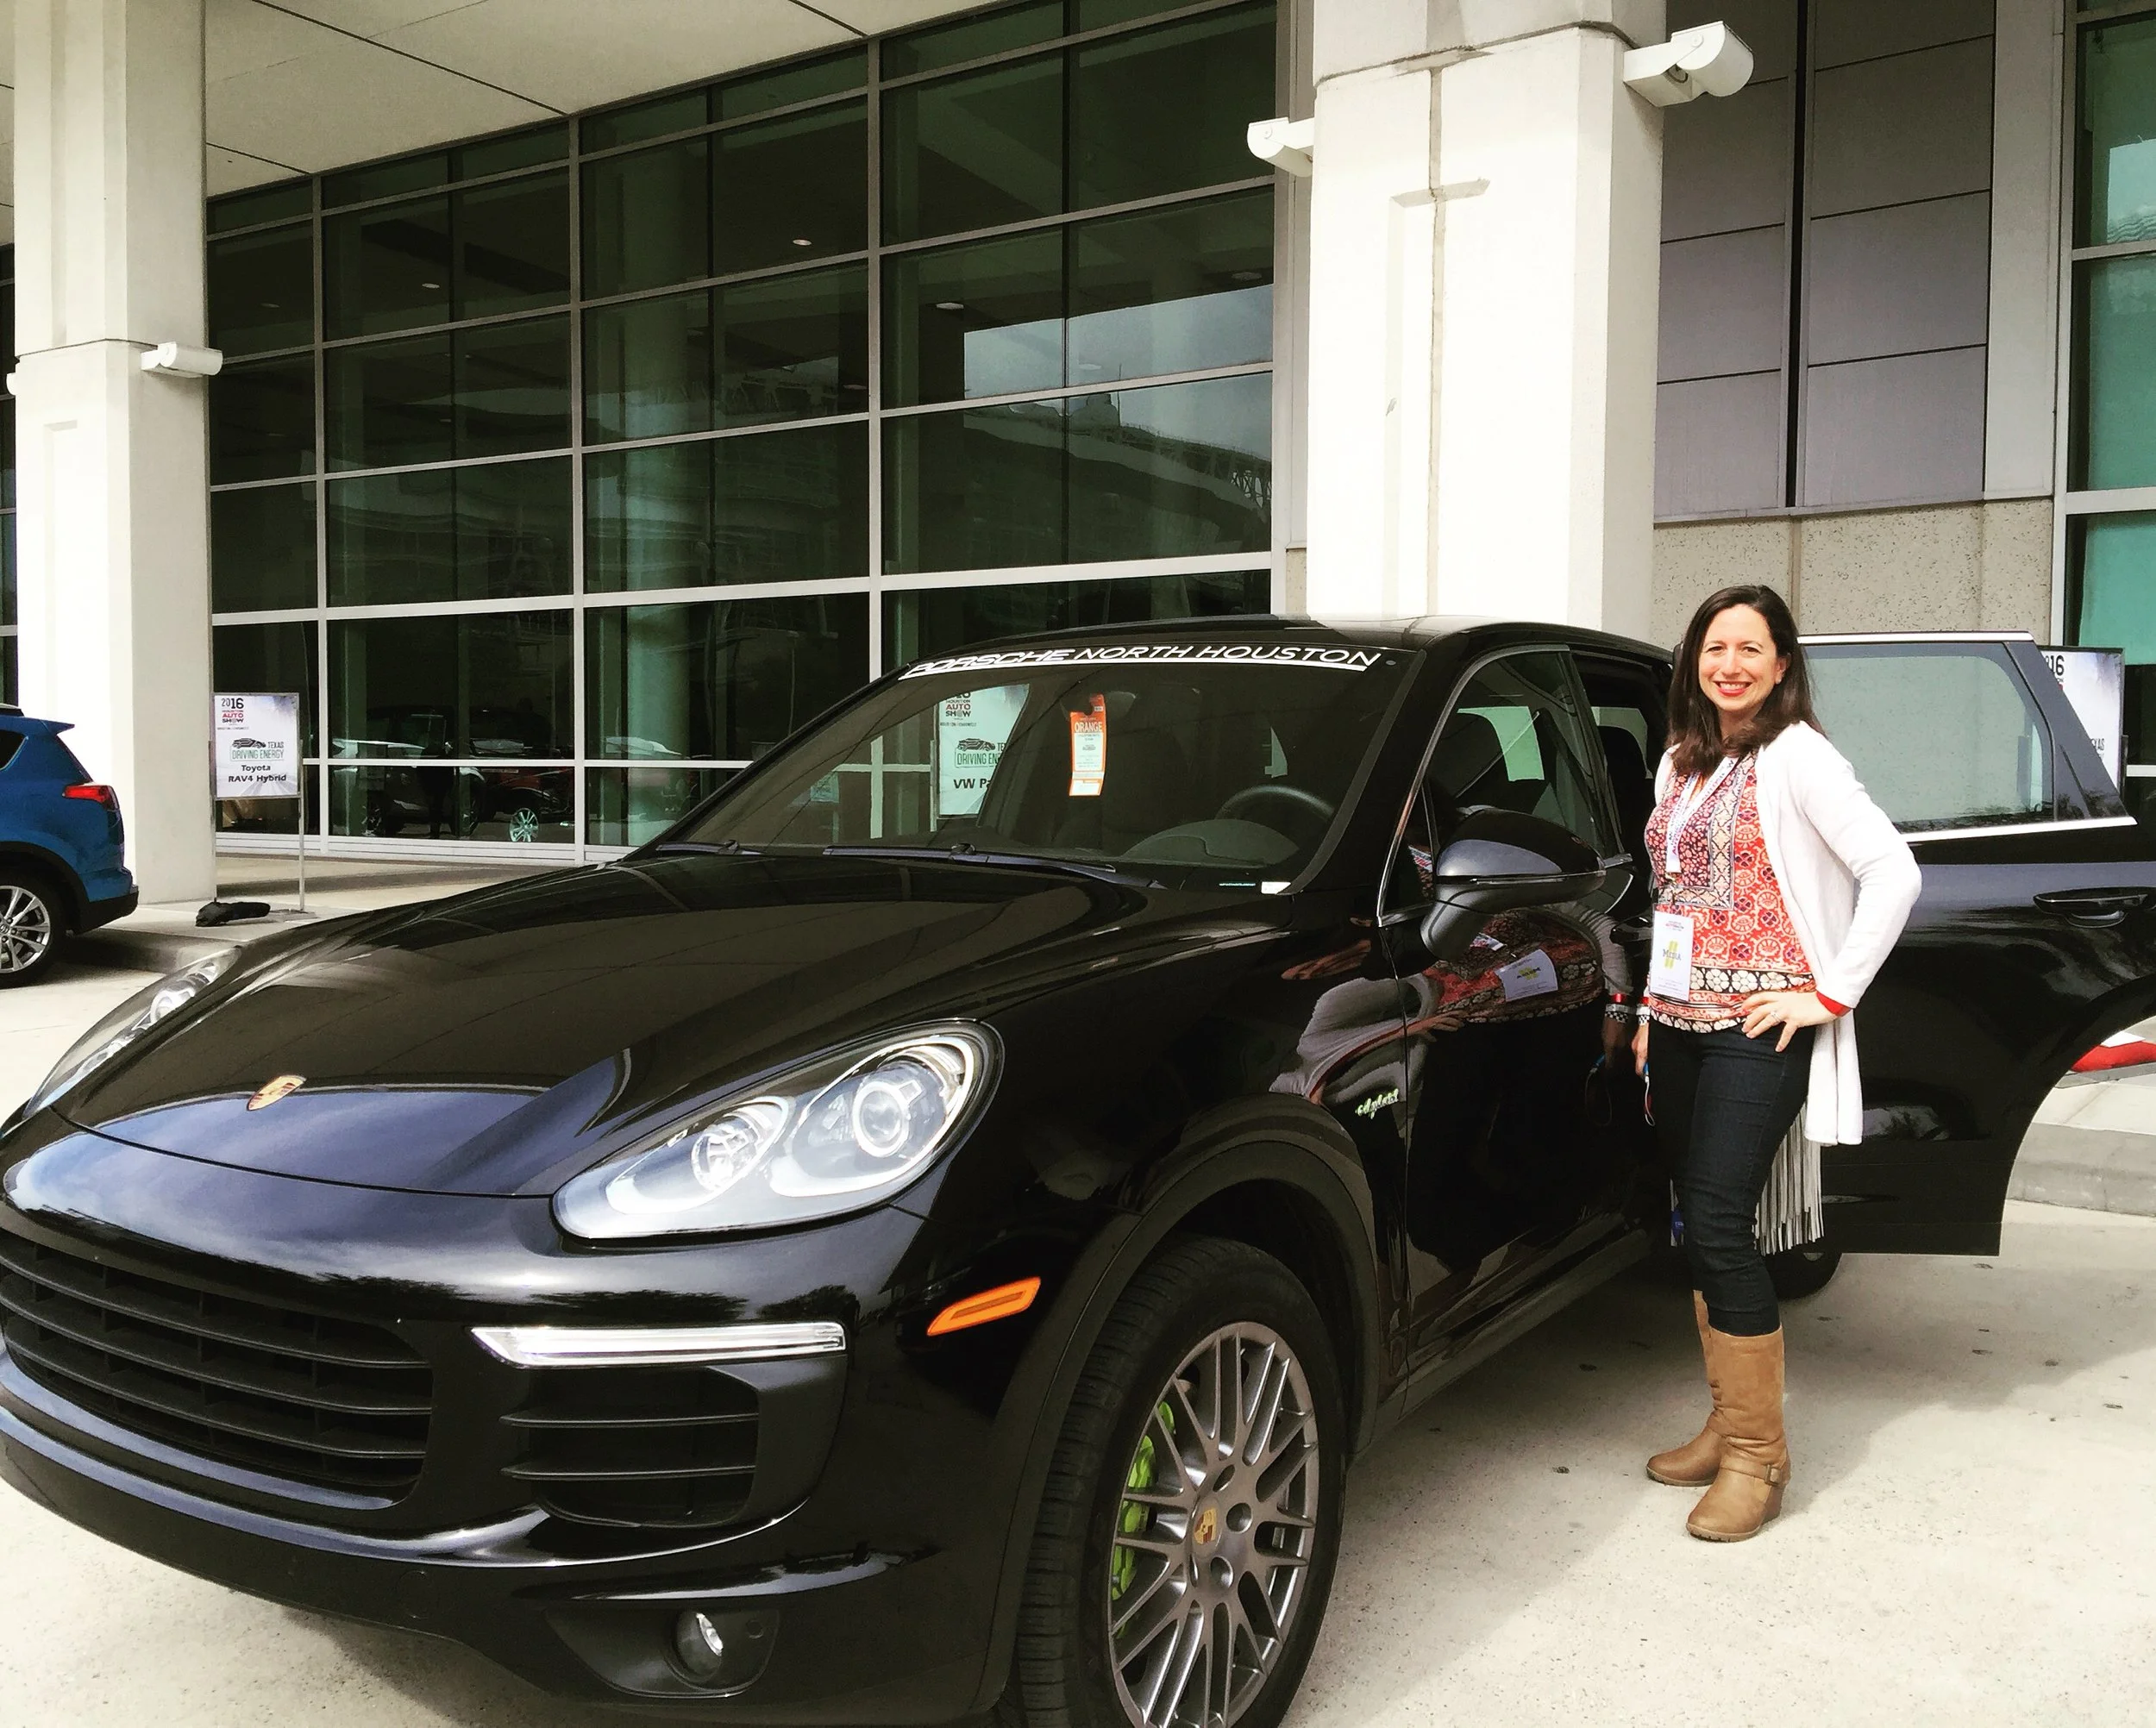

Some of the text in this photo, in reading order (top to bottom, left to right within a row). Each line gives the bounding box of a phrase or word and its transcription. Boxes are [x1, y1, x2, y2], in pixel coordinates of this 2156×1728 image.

[904, 645, 1382, 676] PORSCHE NORTH HOUSTON
[221, 698, 244, 709] 2016
[1075, 721, 1103, 733] ORANGE
[232, 748, 285, 760] DRIVING ENERGY
[957, 753, 987, 765] DRIVING
[241, 765, 271, 773] Toyota
[256, 774, 286, 784] Hybrid
[953, 778, 975, 789] VW
